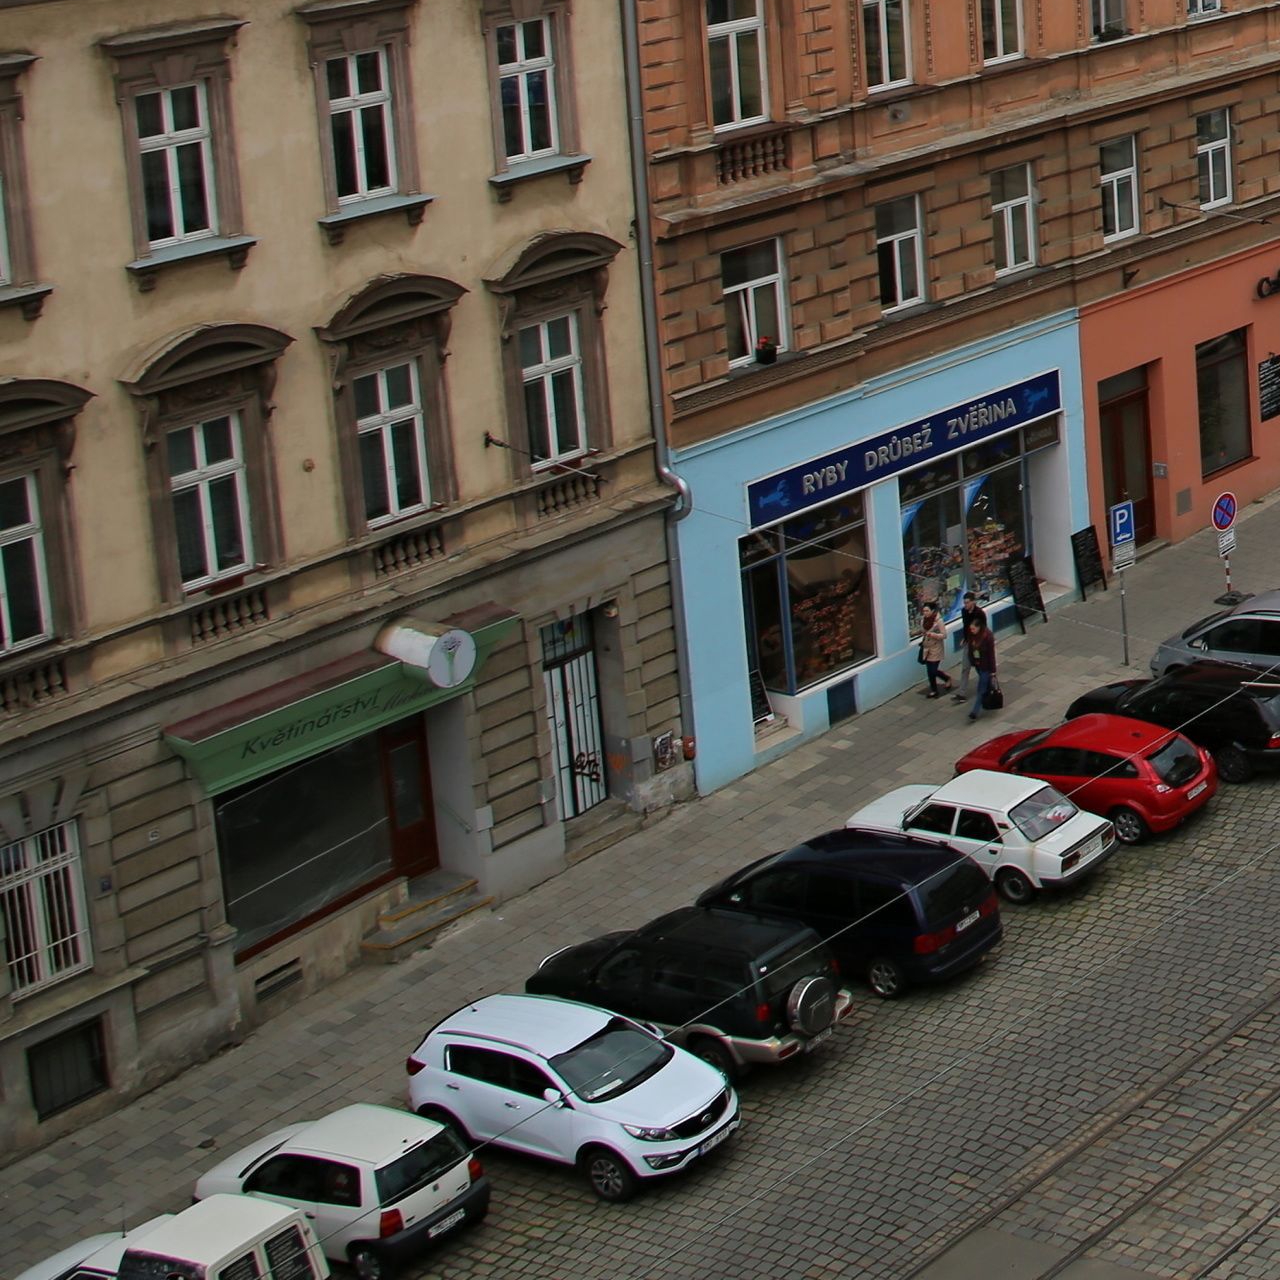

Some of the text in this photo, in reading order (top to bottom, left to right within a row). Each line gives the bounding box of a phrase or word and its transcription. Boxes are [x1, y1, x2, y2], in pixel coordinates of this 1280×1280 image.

[802, 398, 1017, 495] RYBY DRŮBEŽ ZVĚŘINA
[241, 688, 381, 759] Květinářství
